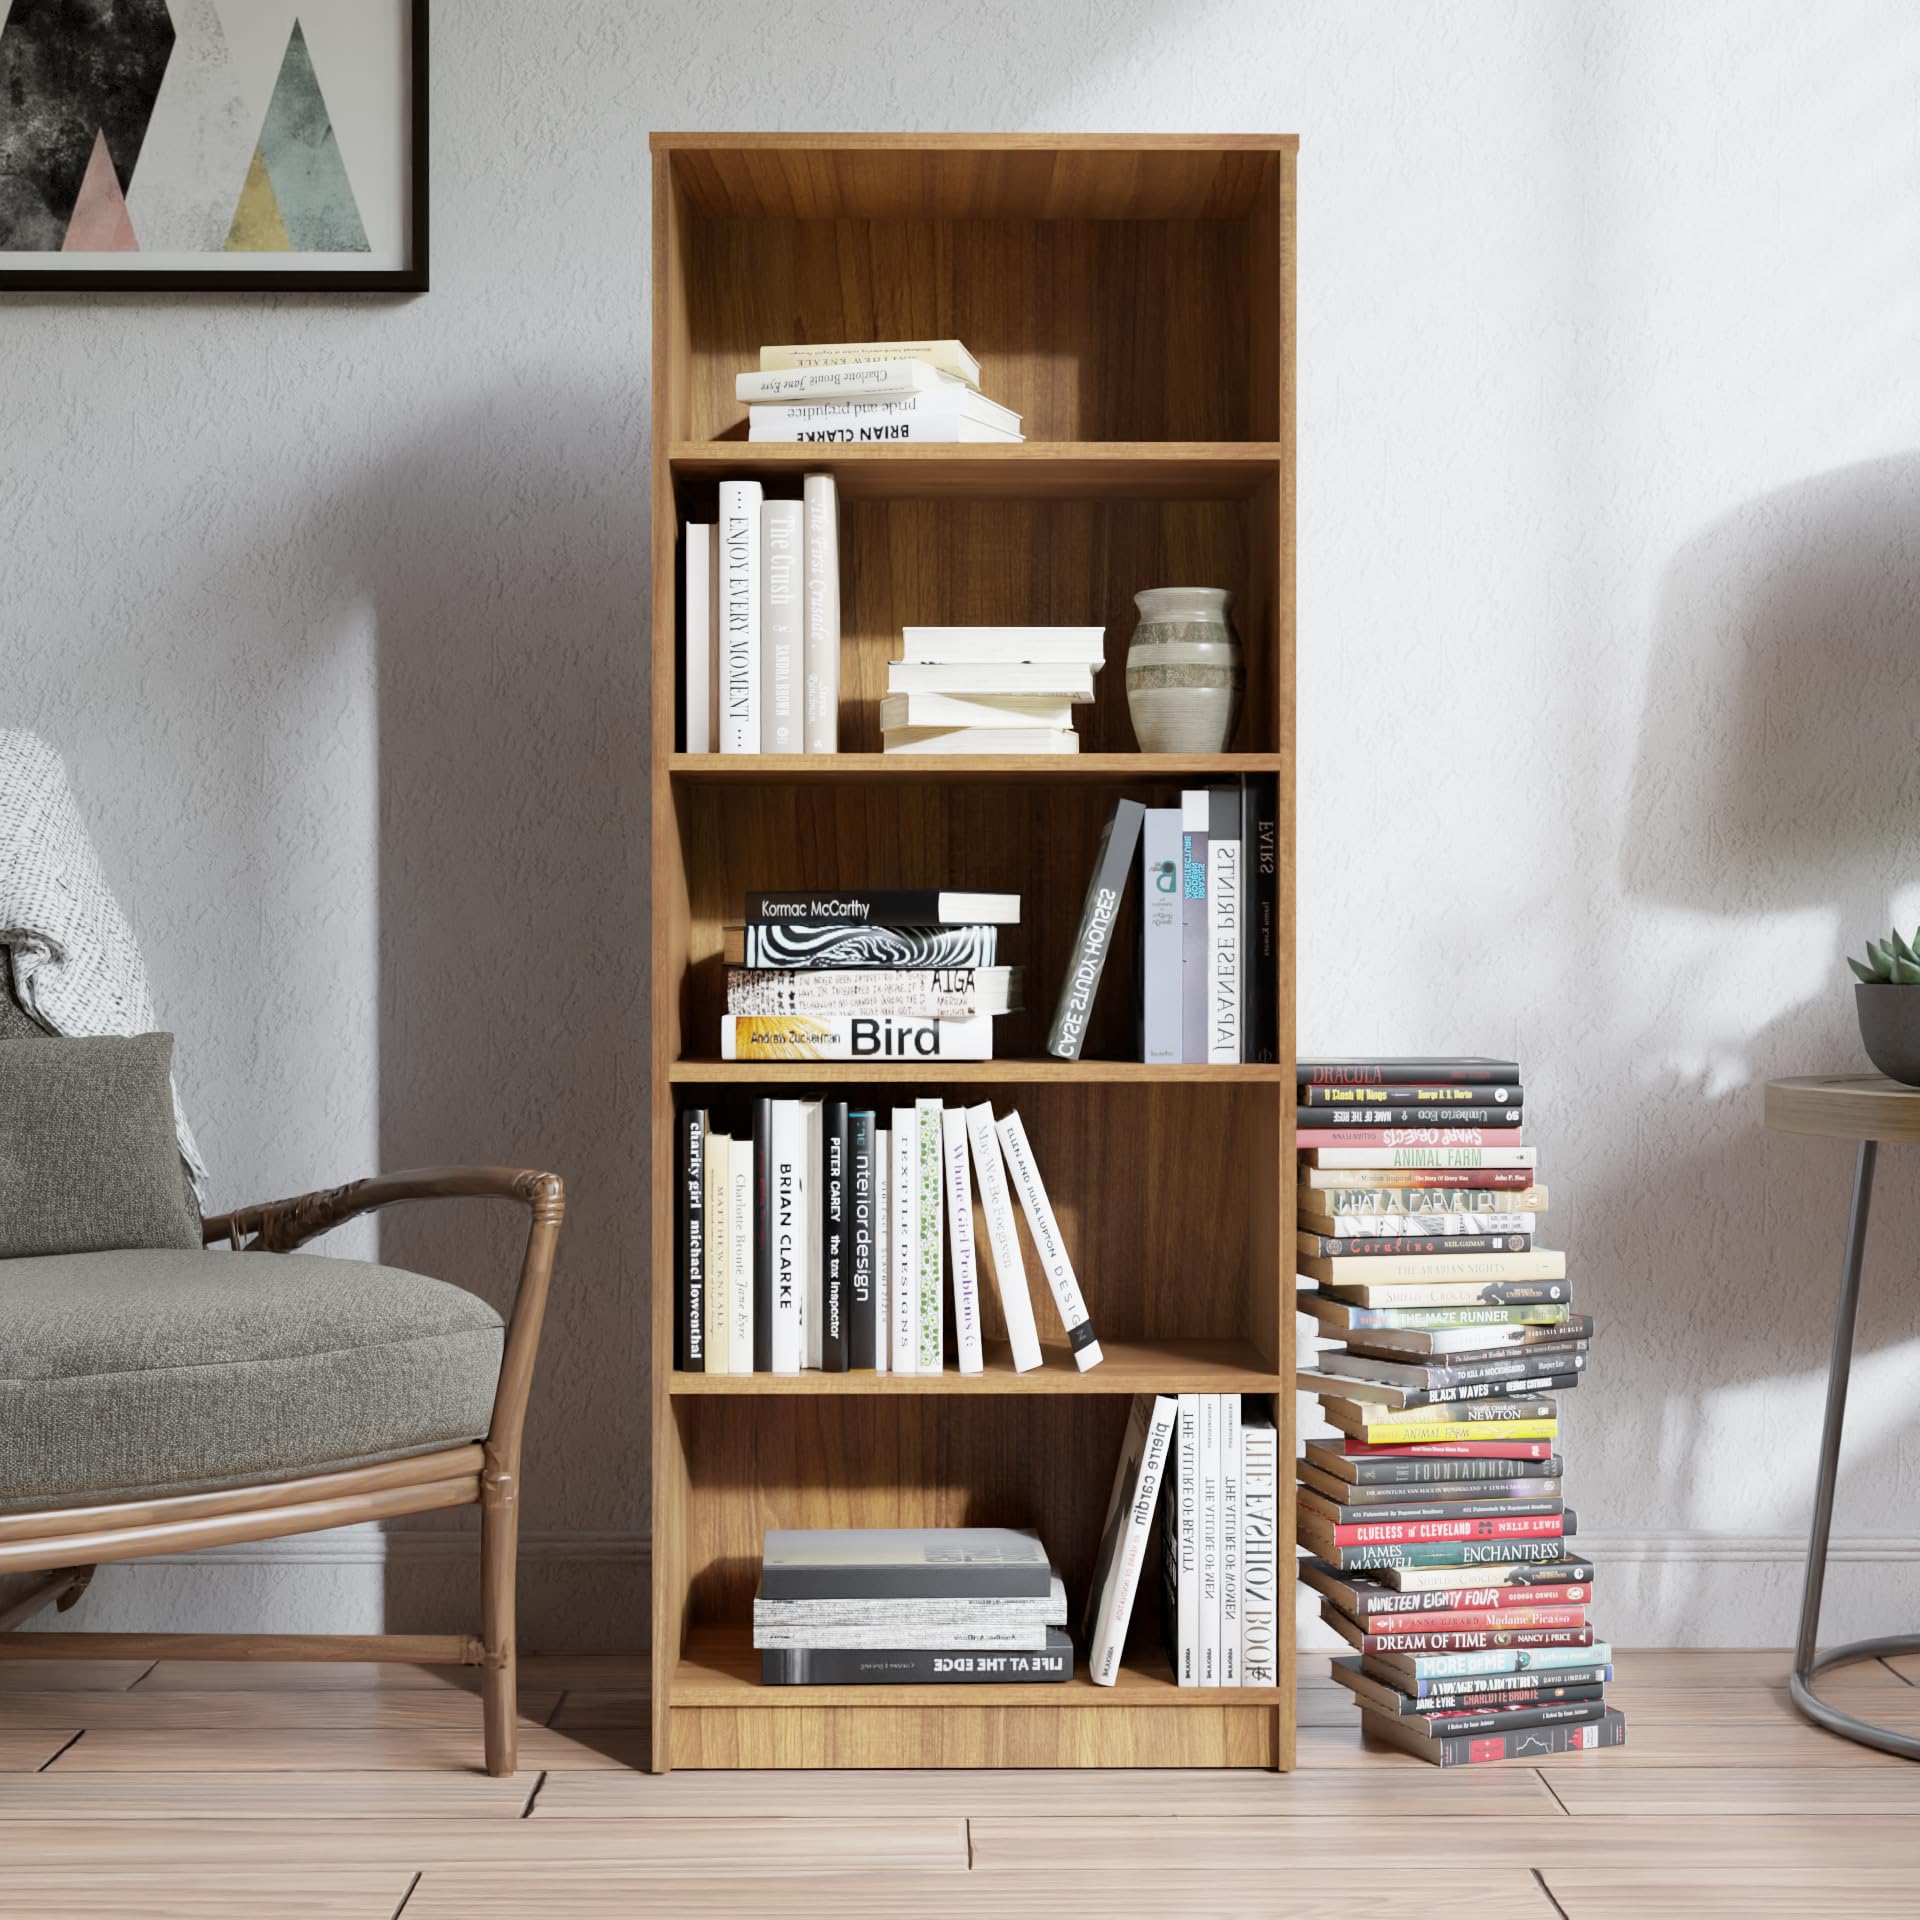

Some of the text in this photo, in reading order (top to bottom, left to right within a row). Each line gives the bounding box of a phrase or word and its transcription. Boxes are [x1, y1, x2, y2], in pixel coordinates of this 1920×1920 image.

[784, 377, 807, 391] Jane
[844, 370, 888, 384] Charlotte
[787, 399, 851, 421] prejudice
[854, 403, 878, 418] and
[796, 424, 910, 442] BRIAN CLARKE
[770, 517, 796, 605] The Crush
[727, 517, 749, 722] ENJOY EVERY MOMENT
[762, 900, 870, 920] Kormac McCarthy
[931, 969, 975, 993] AIGA
[851, 1018, 940, 1055] Bird
[1312, 1066, 1382, 1084] DRACULA
[1333, 1111, 1392, 1122] NAME OF THE ROSE
[1418, 1110, 1488, 1121] Umberto Eco
[1383, 1128, 1482, 1145] SHARP OBJECTS
[1394, 1149, 1482, 1166] ANIMAL FARM
[830, 1137, 841, 1222] PETER CAREY
[1007, 1128, 1057, 1259] ELLEN AND JULIA LUPTON
[736, 1174, 746, 1232] Charlotte
[1339, 1193, 1379, 1213] WHAT
[1386, 1193, 1399, 1214] A
[957, 1206, 969, 1245] Girl
[688, 1122, 702, 1359] charity girl michael lowenthal
[780, 1163, 792, 1309] BRIAN CLARKE
[1421, 1264, 1466, 1275] ARABIAN
[1468, 1263, 1505, 1273] NIGHTS
[960, 1250, 974, 1332] Problems
[1401, 1312, 1423, 1324] THE
[1424, 1311, 1457, 1324] MAZE
[1460, 1310, 1509, 1323] RUNNER
[1458, 1370, 1466, 1379] TO
[1467, 1370, 1478, 1378] KILL
[1486, 1364, 1525, 1376] MOCKINGBIRD
[1429, 1384, 1489, 1402] BLACK WAVES
[1468, 1411, 1521, 1421] NEWTON
[1403, 1426, 1470, 1440] ANIMAL FARM
[1415, 1461, 1524, 1480] FOUNTAINHEAD
[1357, 1522, 1471, 1540] CLUELESS CLEVELAND
[1499, 1519, 1560, 1531] NELLE LEWIS
[1361, 1545, 1401, 1561] JAMES
[1464, 1543, 1559, 1563] ENCHANTRESS
[1350, 1557, 1413, 1571] MAXWELL
[1368, 1588, 1500, 1612] NINETEEN EIGHTY FOUR
[1410, 1616, 1479, 1627] ANNE GIRARD
[1486, 1612, 1570, 1625] Madame Picasso
[1376, 1632, 1487, 1651] DREAM OF TIME
[1518, 1633, 1571, 1643] NANCY PRICE
[1424, 1654, 1505, 1675] MORE ME
[1431, 1684, 1438, 1696] A
[1438, 1681, 1474, 1694] VOYAGE
[1475, 1679, 1487, 1691] TO
[1543, 1673, 1591, 1684] DAVID LINDSAY
[1416, 1696, 1456, 1710] JANE EYRE
[1463, 1693, 1507, 1705] CHARLOTTE
